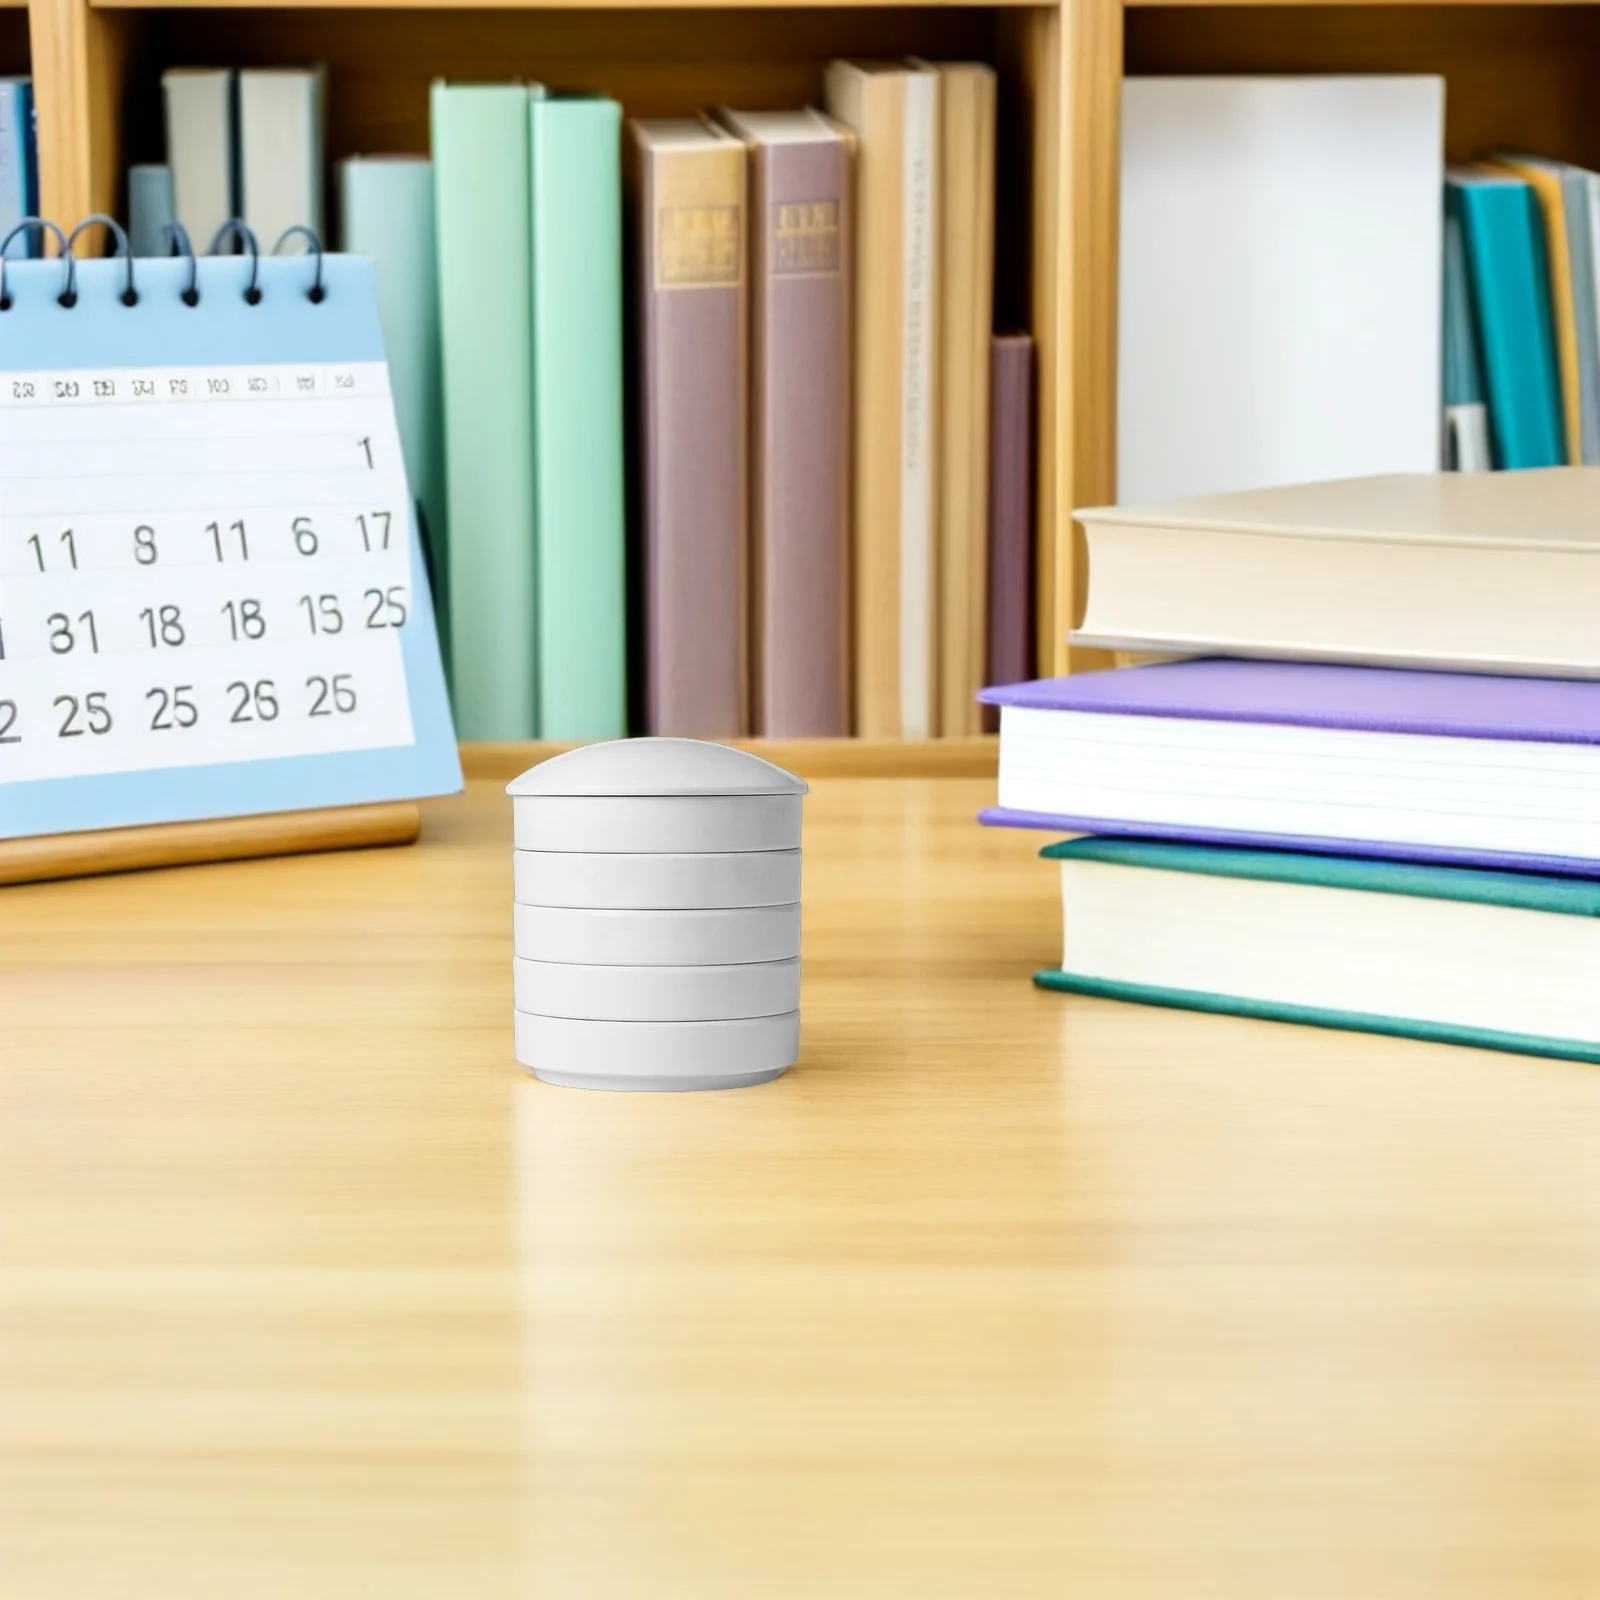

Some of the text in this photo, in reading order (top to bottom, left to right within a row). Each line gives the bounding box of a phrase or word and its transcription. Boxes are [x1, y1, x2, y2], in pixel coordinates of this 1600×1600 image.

[358, 437, 374, 470] 1
[133, 525, 158, 566] 8
[205, 518, 249, 563] 11
[291, 516, 319, 557] 6
[355, 511, 393, 553] 17
[138, 604, 186, 649] 18
[220, 598, 267, 642] 18
[363, 586, 407, 630] 25
[52, 691, 114, 739] 25
[144, 684, 199, 732] 25
